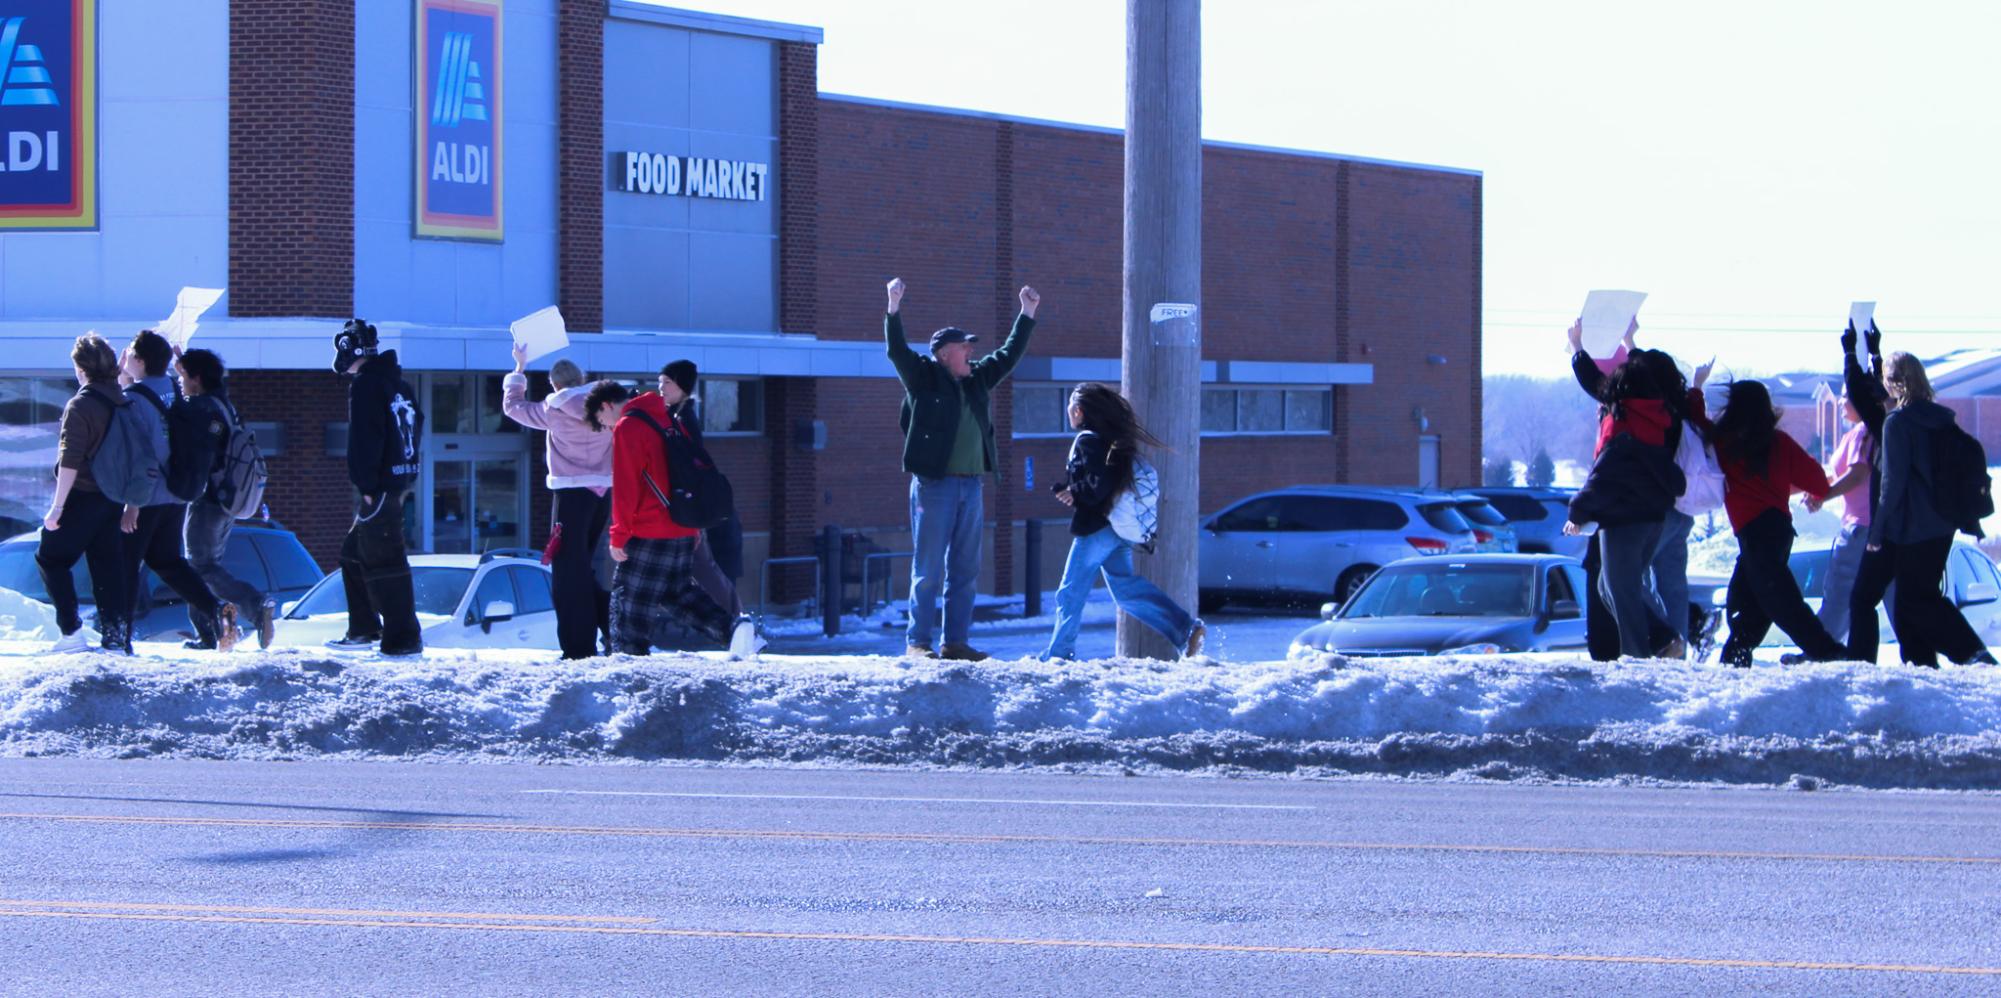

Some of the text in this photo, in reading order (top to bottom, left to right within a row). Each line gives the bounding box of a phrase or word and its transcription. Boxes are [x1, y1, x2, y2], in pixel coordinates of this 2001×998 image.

[0, 131, 58, 171] DI
[432, 141, 488, 184] ALDI
[627, 151, 767, 201] FOOD MARKET
